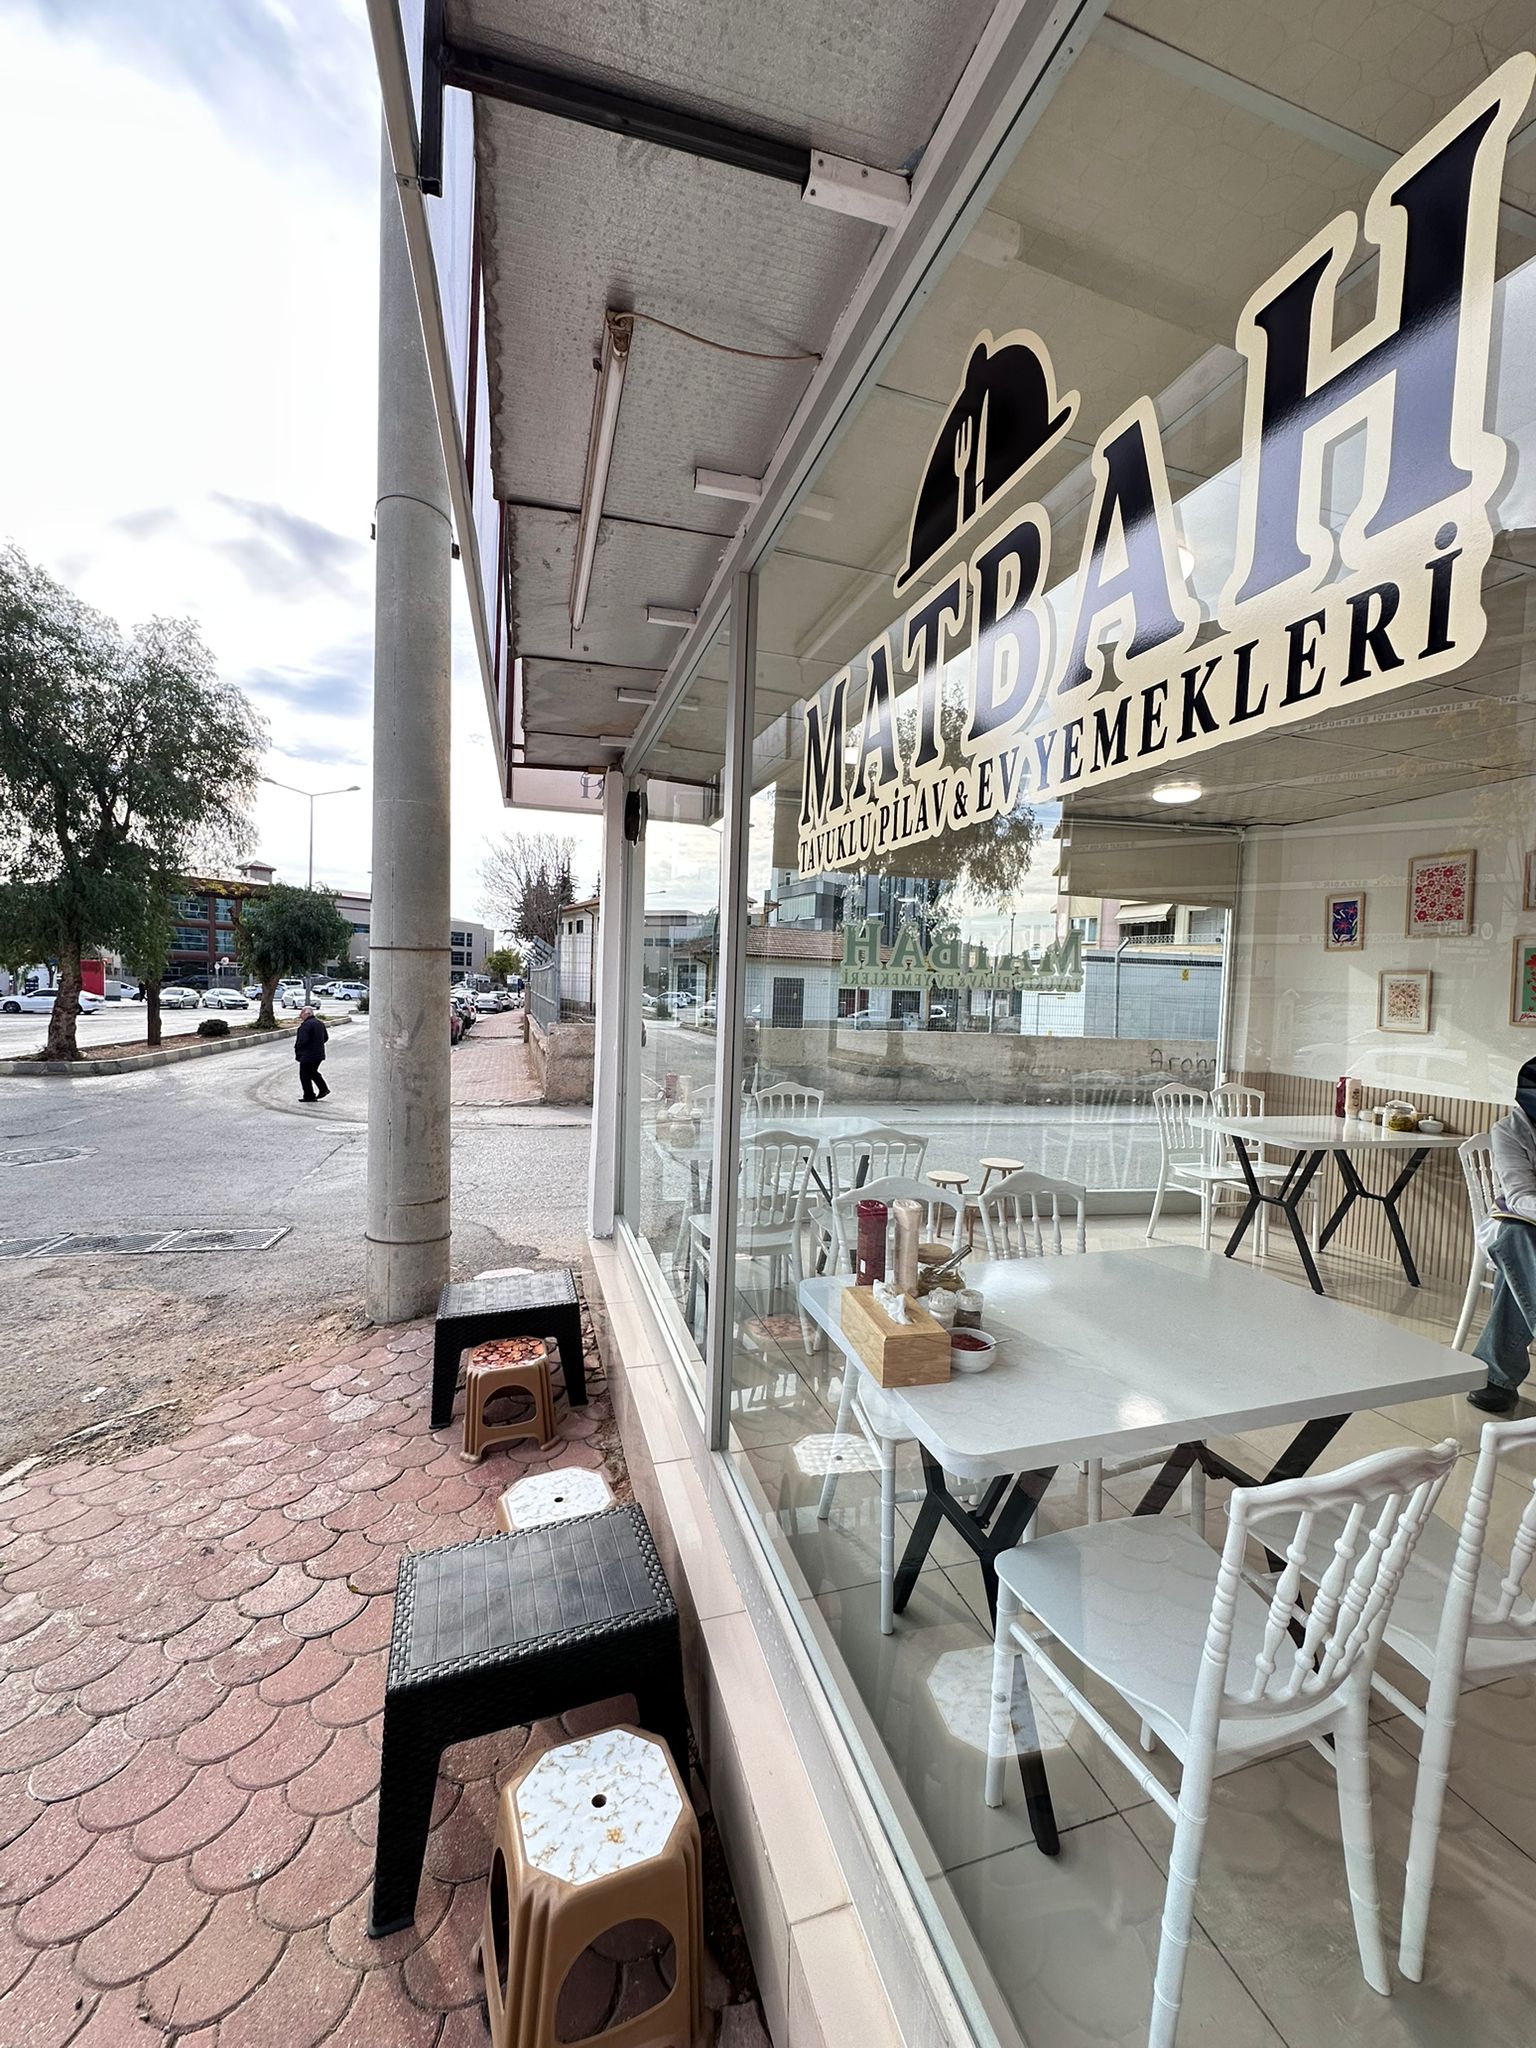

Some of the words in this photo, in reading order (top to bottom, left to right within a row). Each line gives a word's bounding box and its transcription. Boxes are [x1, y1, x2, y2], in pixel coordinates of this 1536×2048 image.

[800, 812, 872, 873] TAVUKLU
[878, 777, 948, 847] PİLAV
[953, 780, 969, 821] &
[976, 746, 1020, 814] EV
[1034, 521, 1464, 792] YEMEKLERİ
[801, 98, 1501, 827] MATBAH
